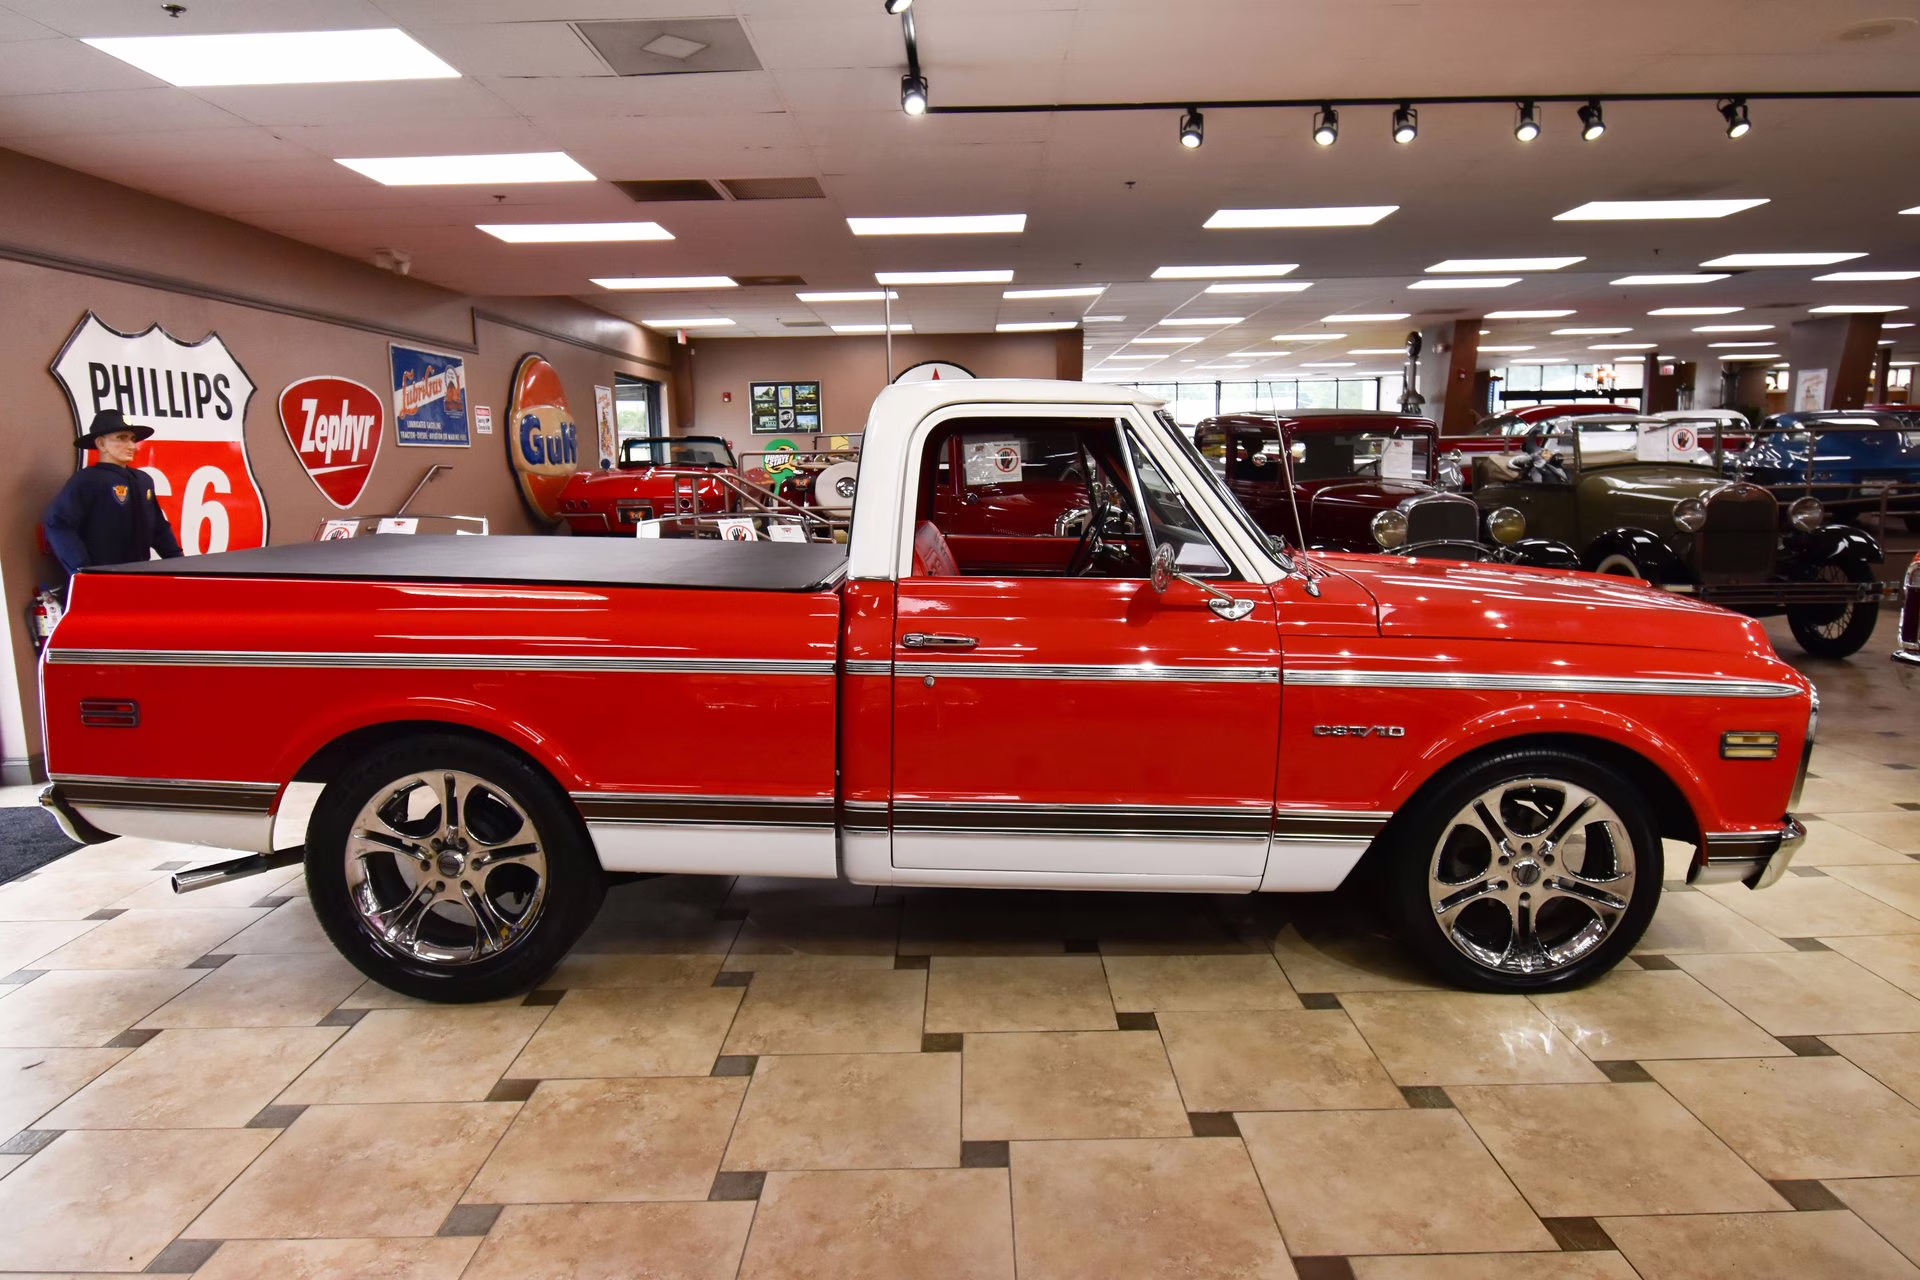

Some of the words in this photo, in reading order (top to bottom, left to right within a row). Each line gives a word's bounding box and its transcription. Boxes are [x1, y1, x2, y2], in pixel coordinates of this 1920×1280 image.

[88, 362, 233, 421] PHILLIPS
[300, 398, 375, 464] Zephyr
[520, 413, 577, 466] Gulf
[768, 455, 790, 468] STATE
[1314, 725, 1405, 737] CST/10
